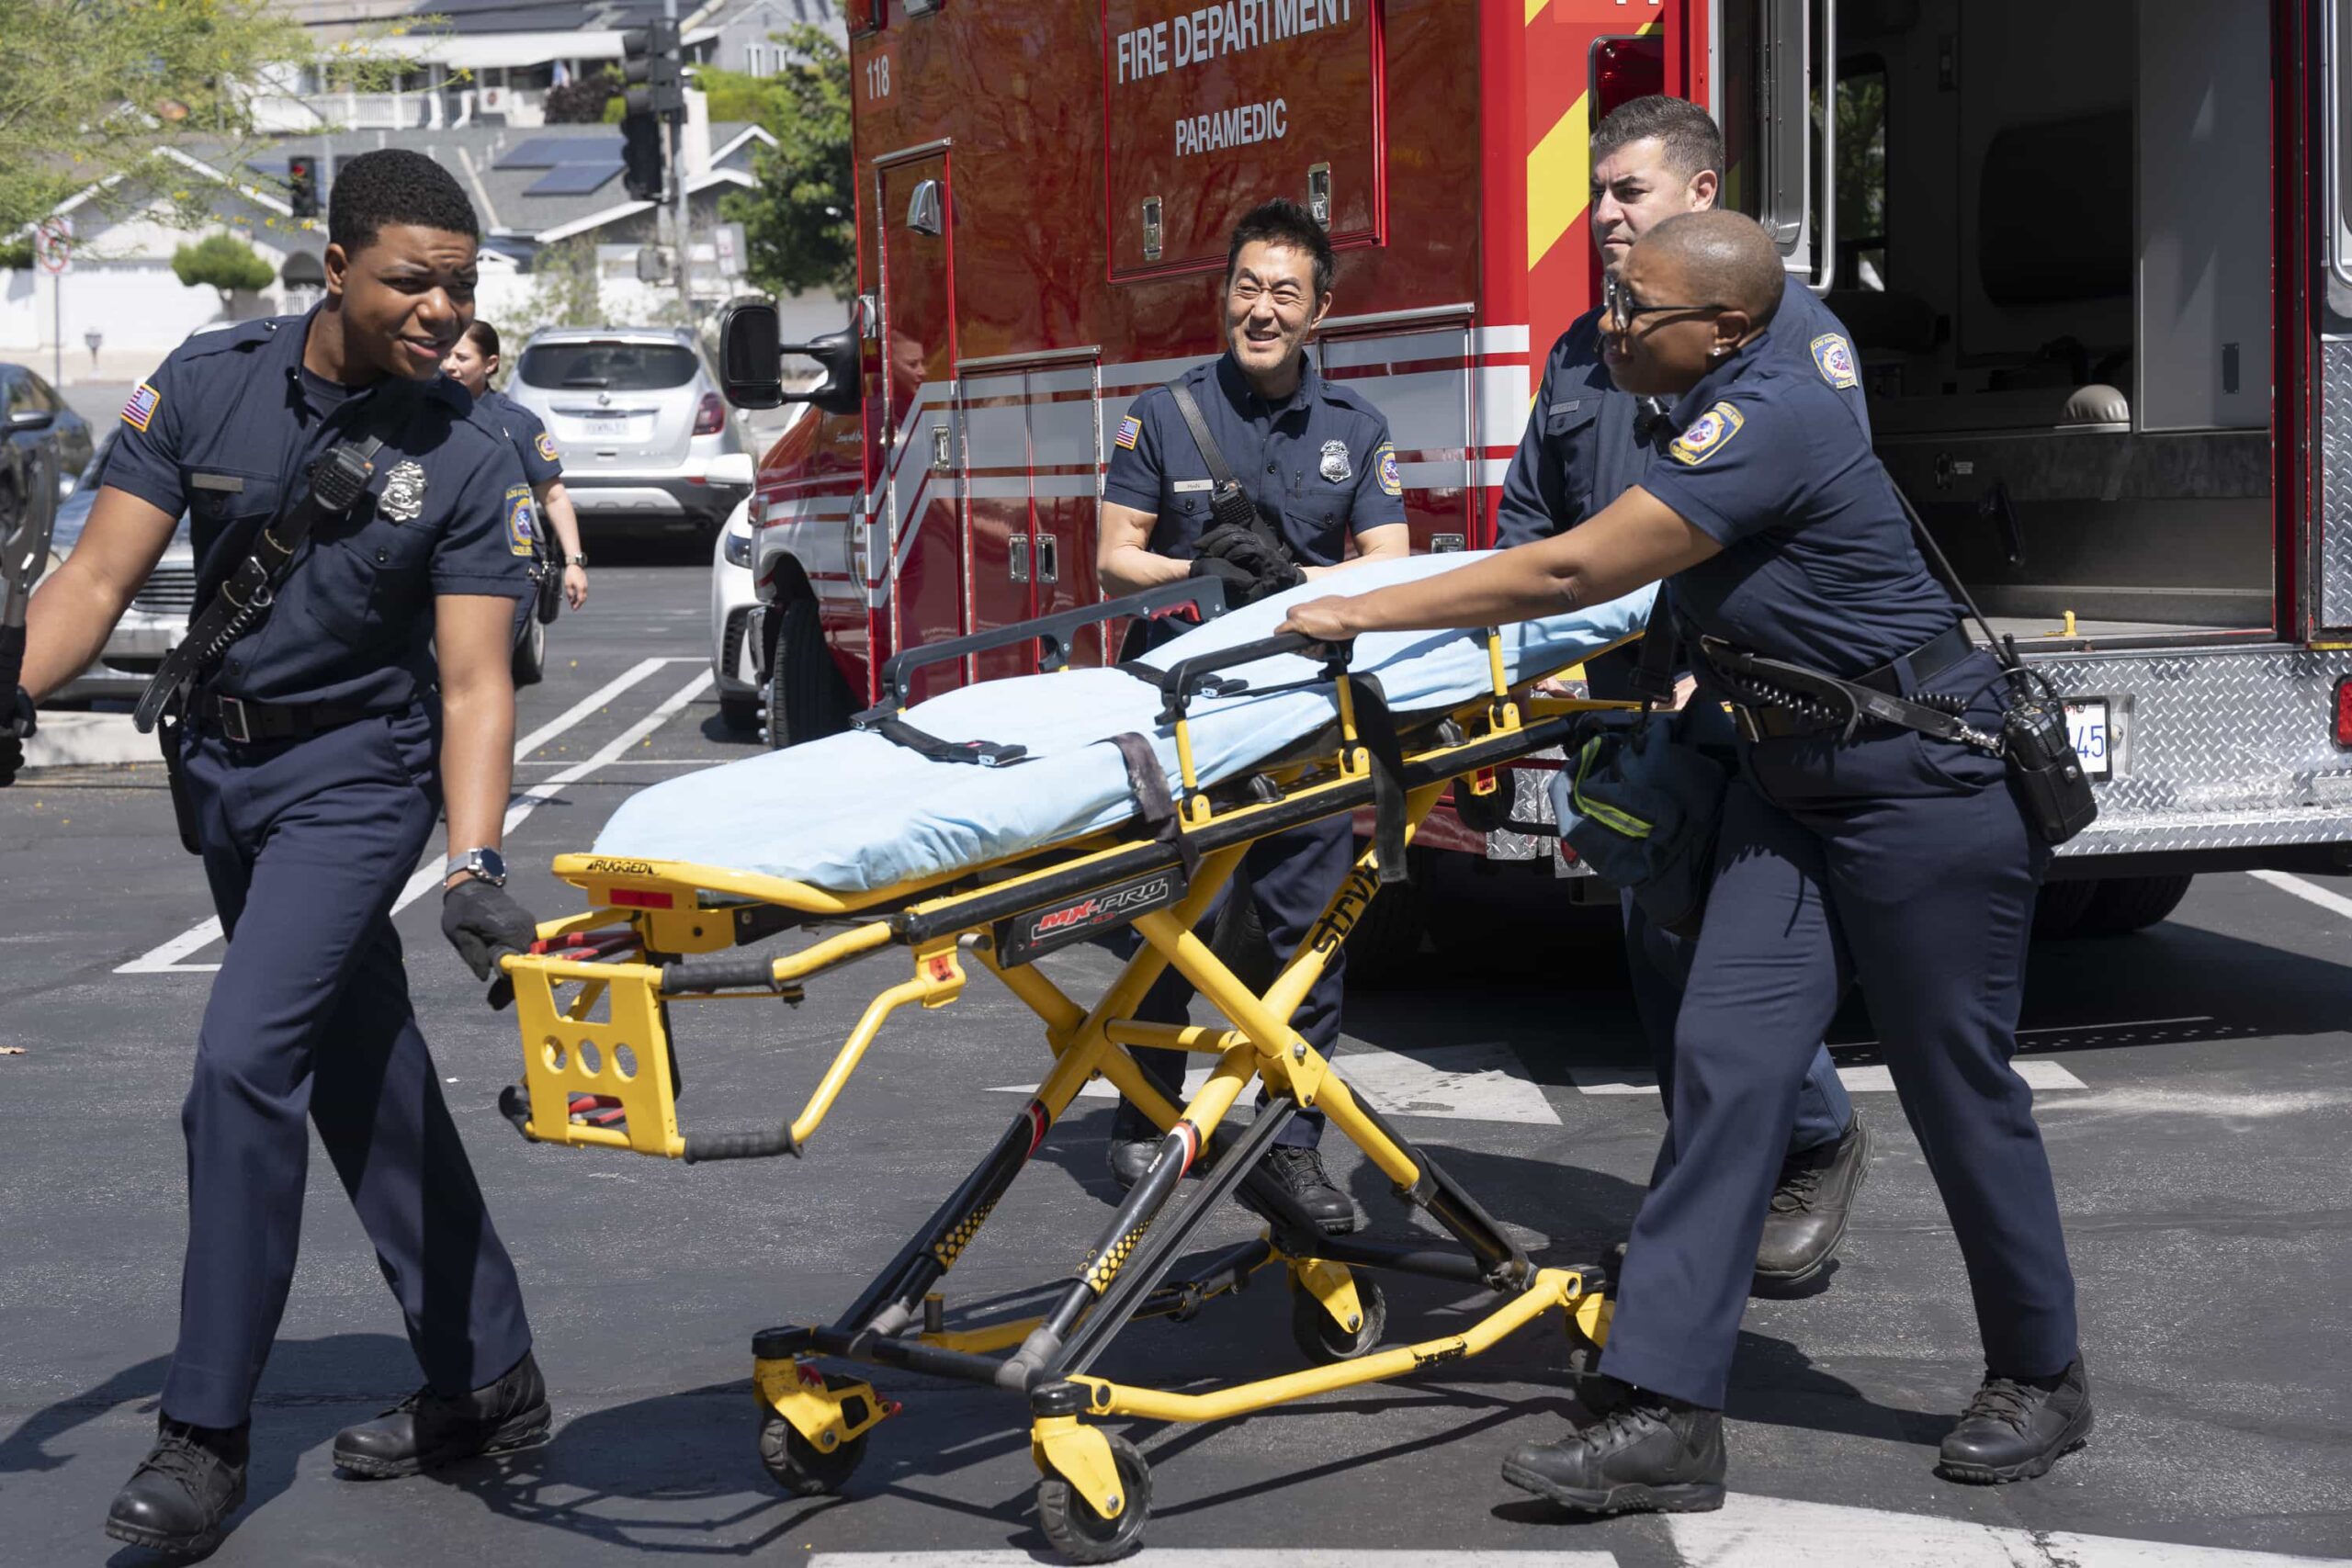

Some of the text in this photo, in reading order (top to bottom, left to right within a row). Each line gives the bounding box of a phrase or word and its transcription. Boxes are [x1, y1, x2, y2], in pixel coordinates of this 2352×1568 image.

[866, 54, 889, 100] 118
[1117, 21, 1168, 85] FIRE
[1175, 97, 1287, 157] PARAMEDIC
[2065, 724, 2105, 759] 45
[593, 859, 648, 874] RUGGED
[1037, 877, 1167, 931] MX-PRO
[1310, 859, 1380, 968] stryk
